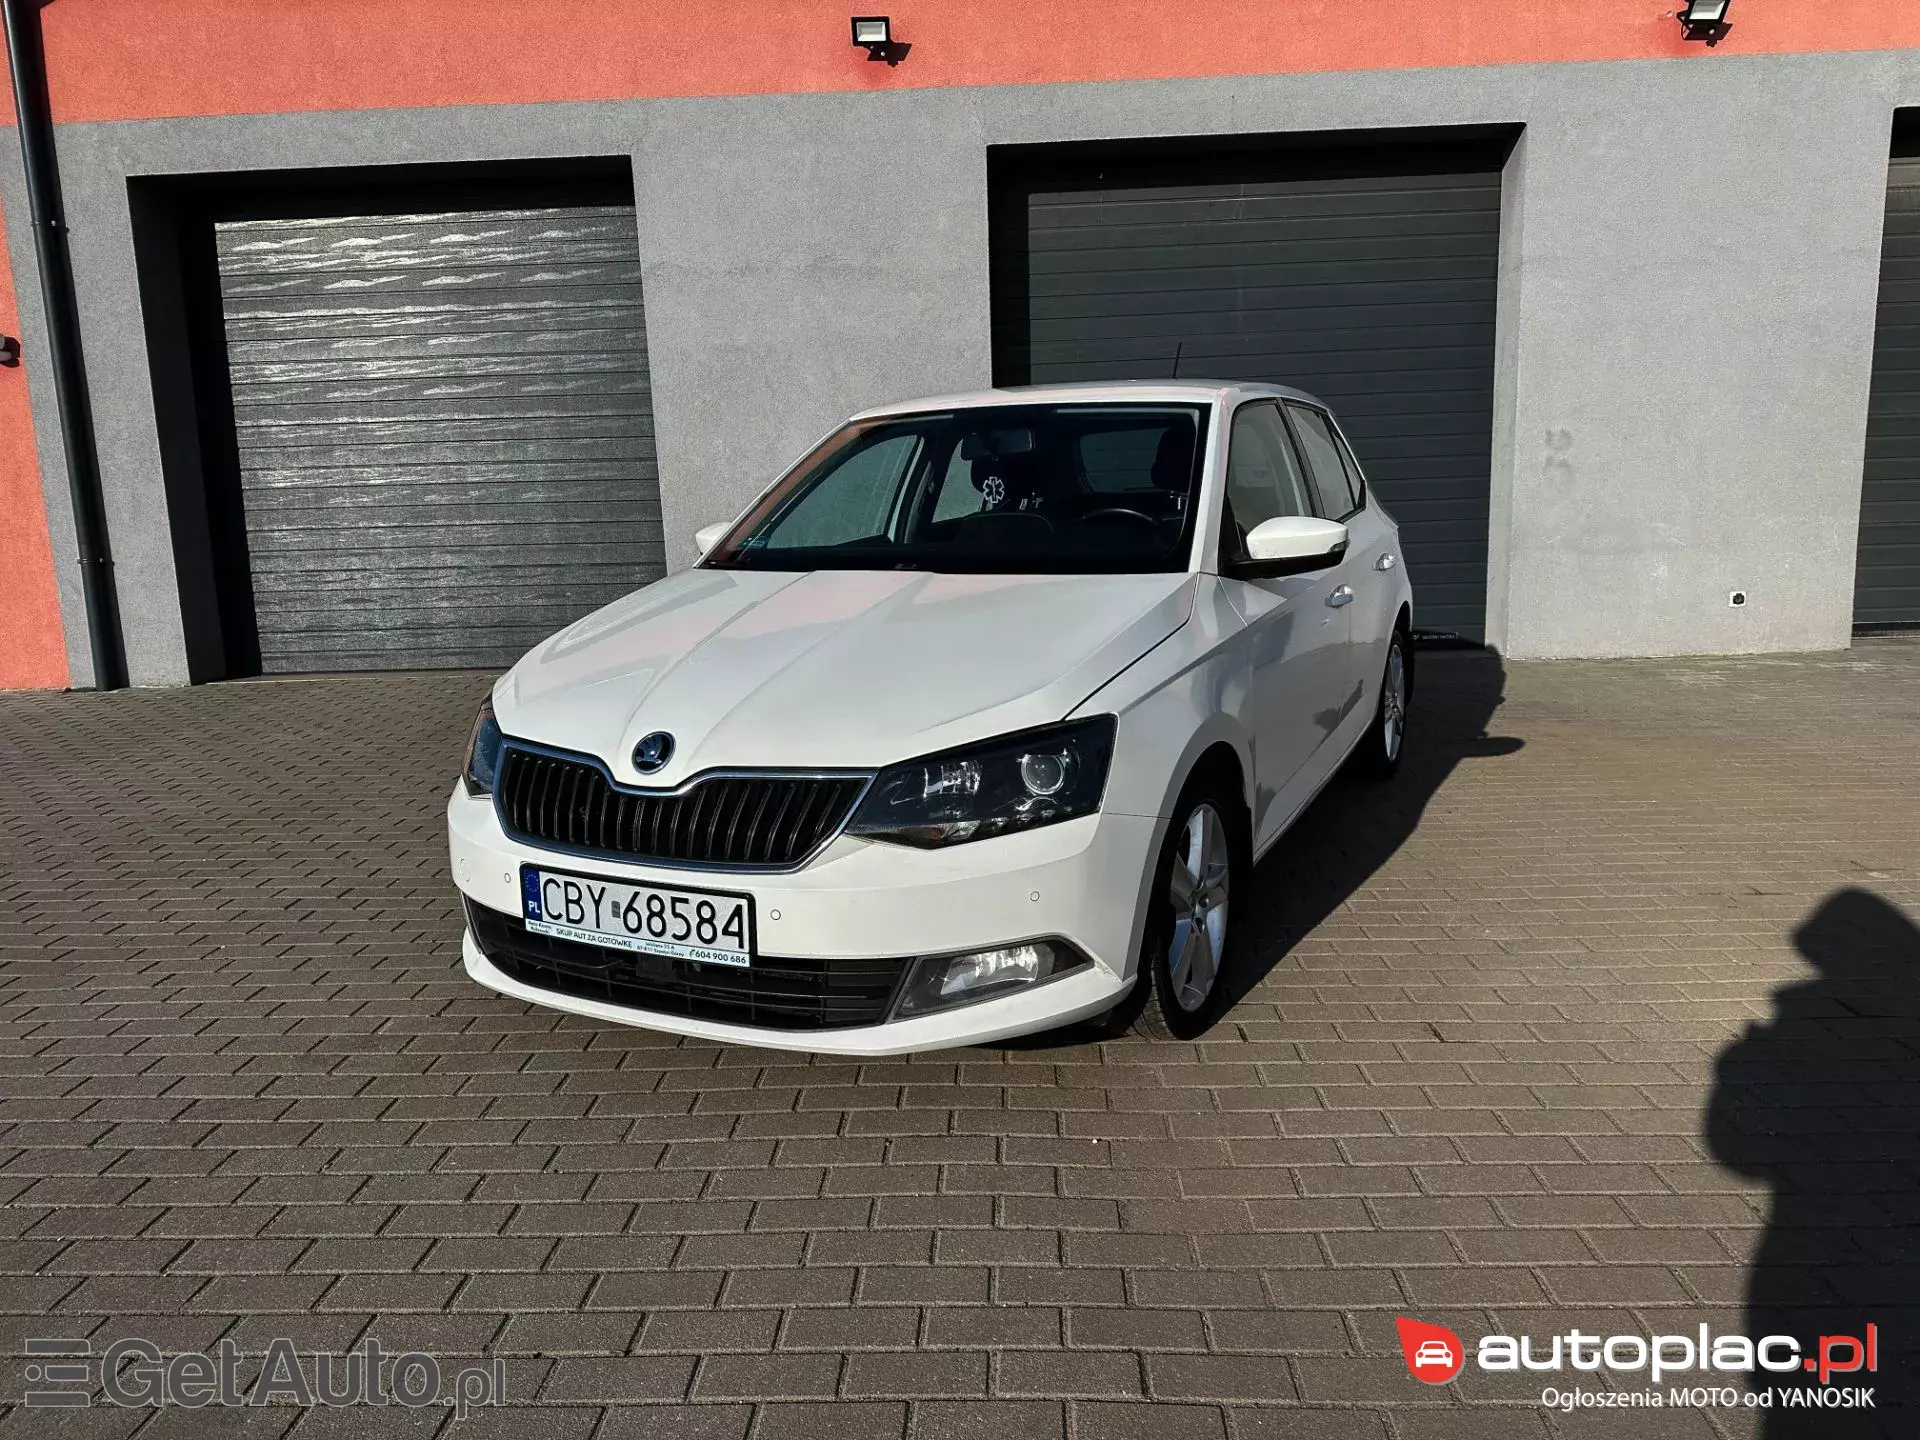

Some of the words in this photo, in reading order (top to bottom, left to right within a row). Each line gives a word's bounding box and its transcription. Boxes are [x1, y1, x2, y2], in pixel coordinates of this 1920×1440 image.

[528, 900, 541, 914] PL
[543, 877, 606, 929] CBY
[622, 891, 746, 949] 68584
[556, 928, 573, 937] SKUP
[573, 932, 586, 940] AUT
[587, 934, 597, 942] ZA
[695, 950, 711, 959] 604
[712, 952, 729, 962] 900
[730, 955, 747, 964] 686
